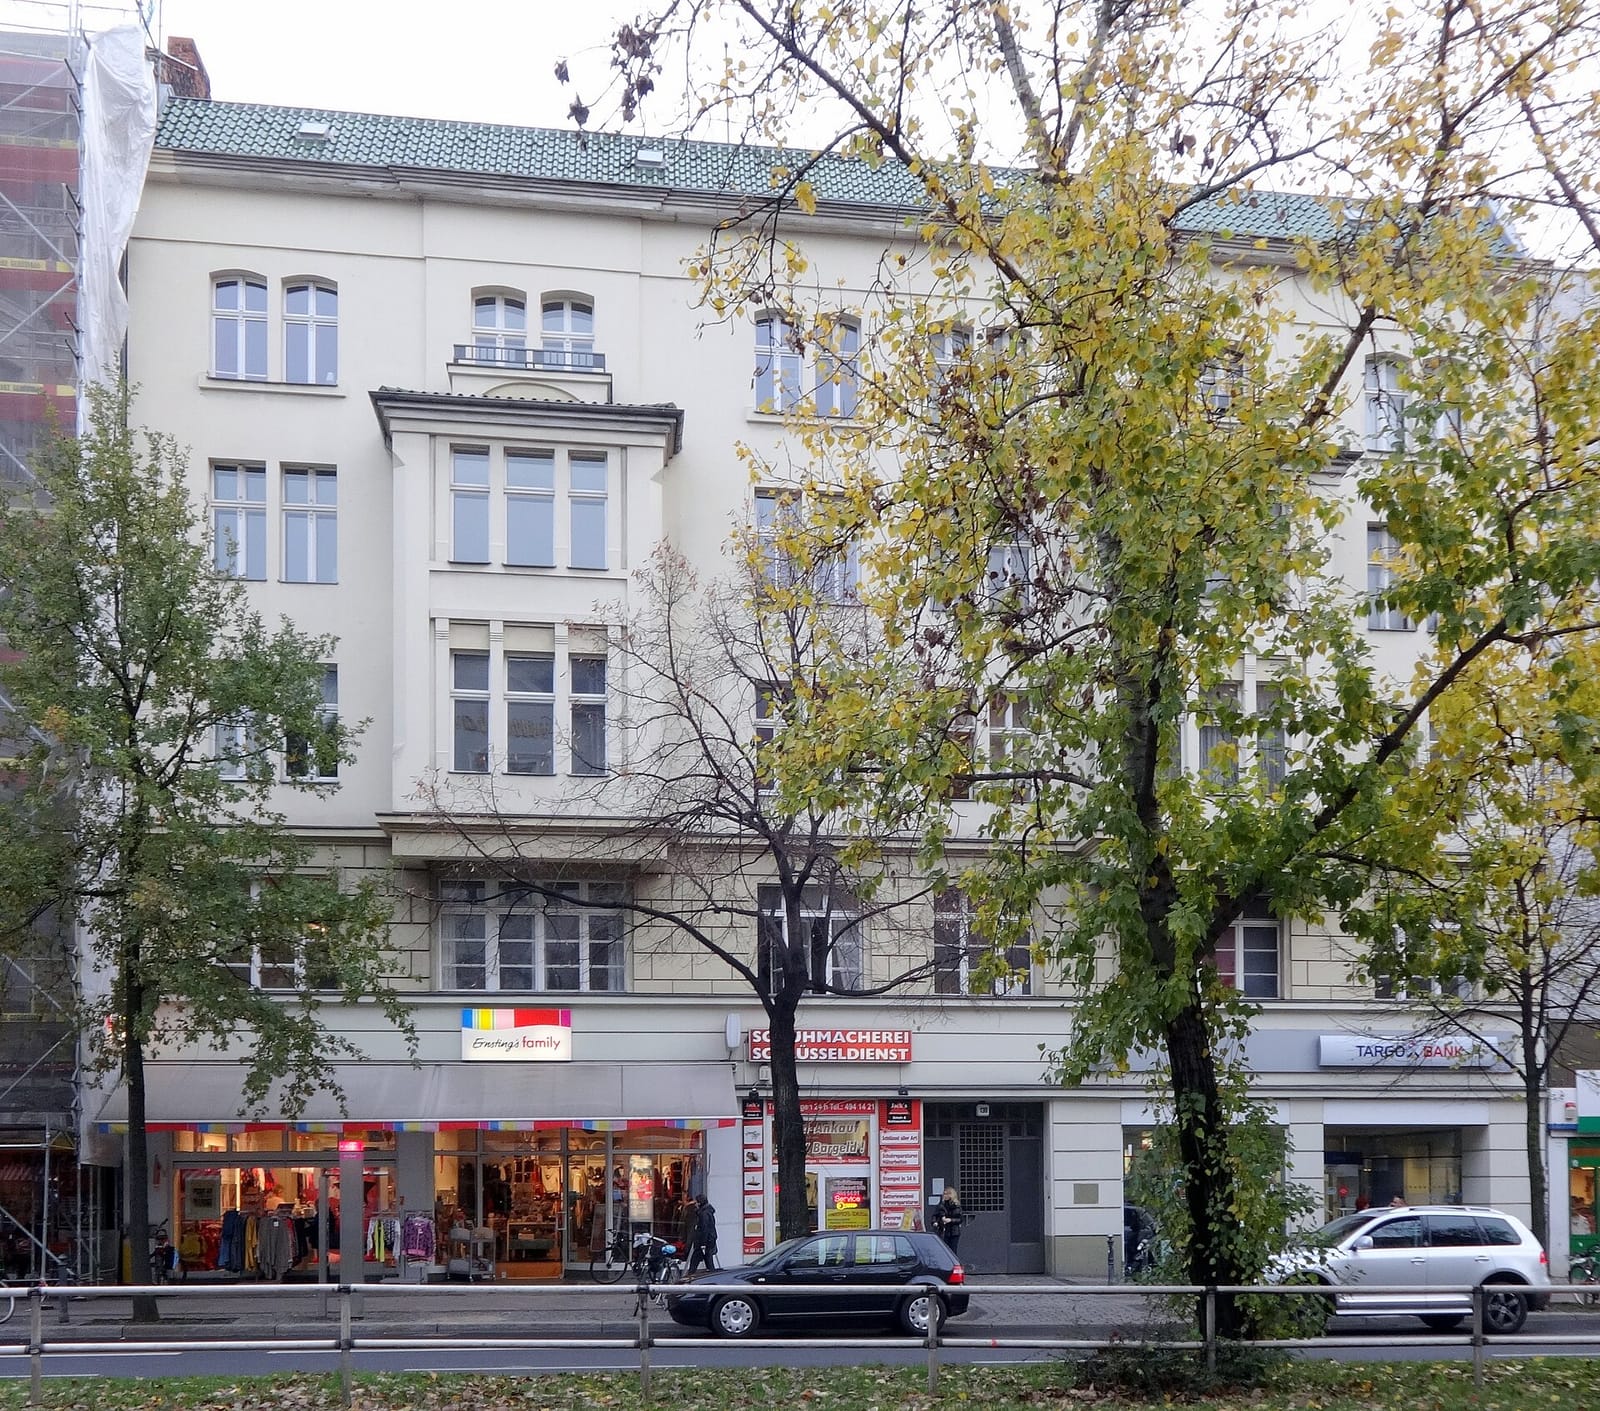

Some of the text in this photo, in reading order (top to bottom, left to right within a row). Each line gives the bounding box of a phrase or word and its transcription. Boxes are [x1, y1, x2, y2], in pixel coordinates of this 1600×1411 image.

[752, 1030, 909, 1043] SCUHMACHEREI
[472, 1035, 561, 1052] Ernsting's family
[752, 1044, 909, 1060] SCÜSSELDIENST
[1355, 1045, 1464, 1058] TARGO BANK
[812, 1141, 858, 1155] Bargeld
[833, 1195, 861, 1203] Service
